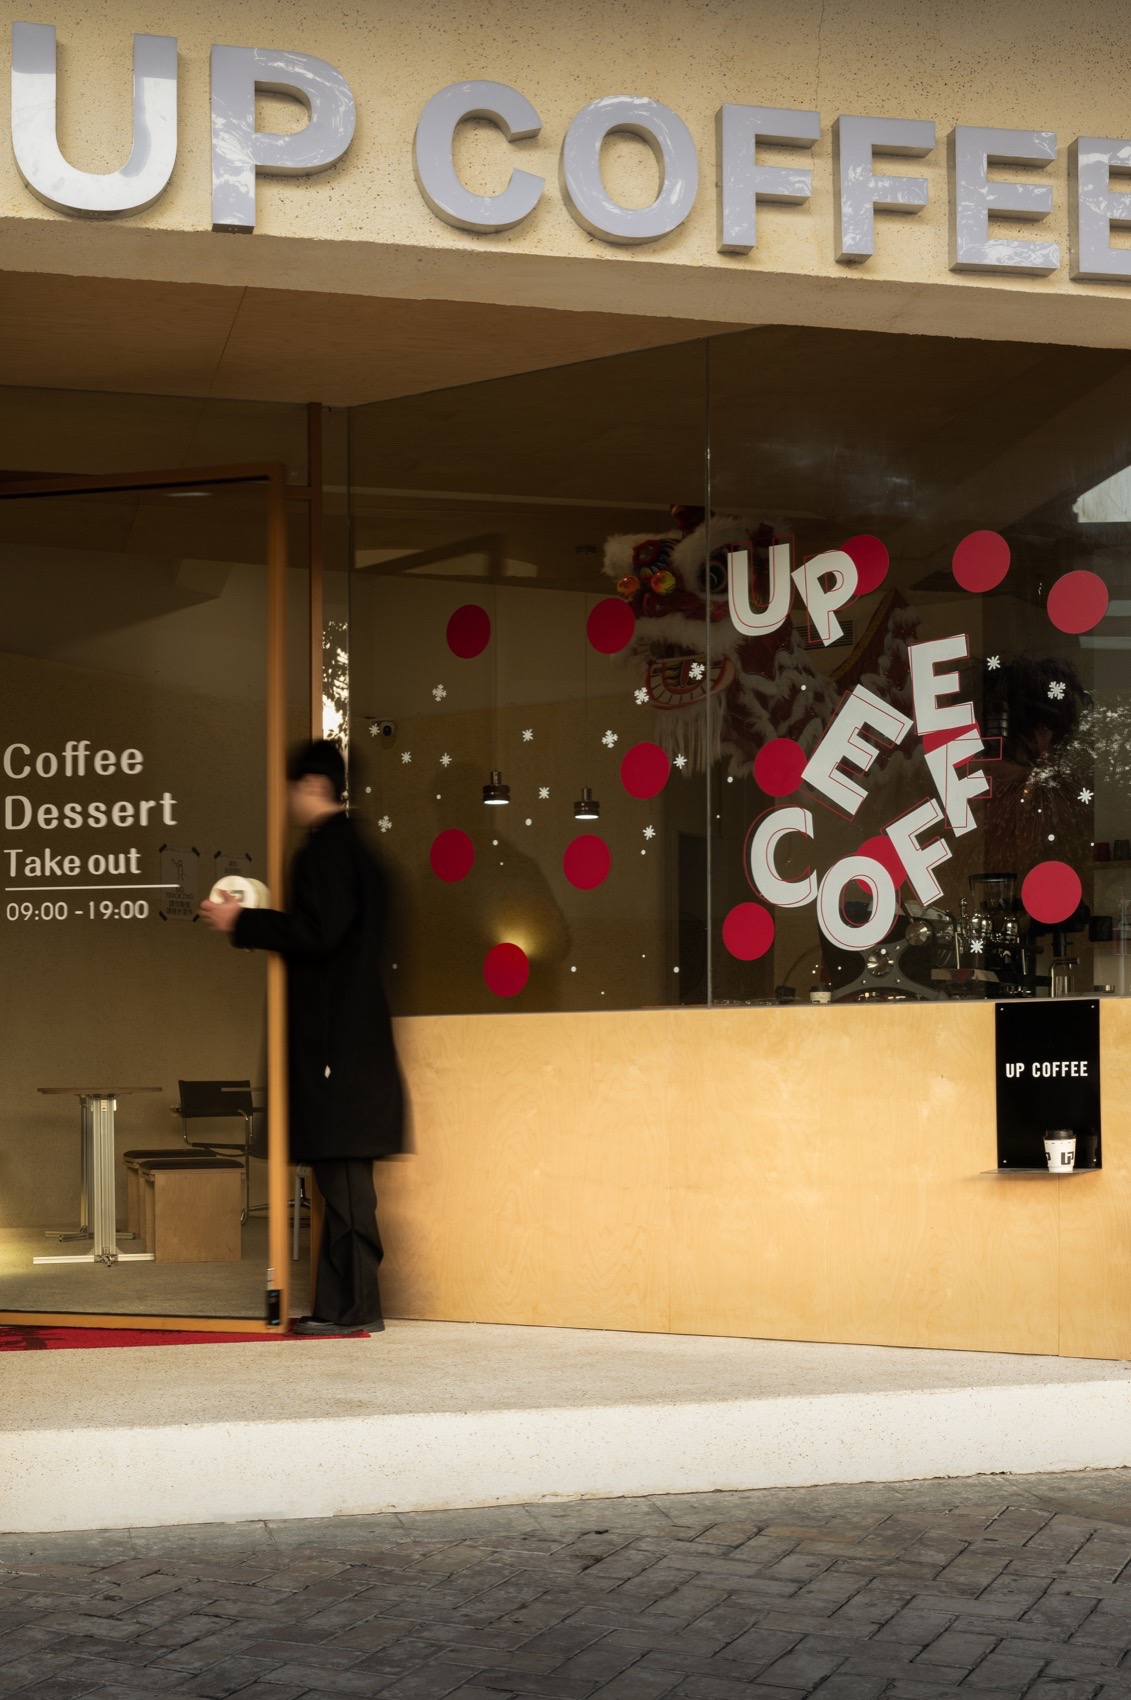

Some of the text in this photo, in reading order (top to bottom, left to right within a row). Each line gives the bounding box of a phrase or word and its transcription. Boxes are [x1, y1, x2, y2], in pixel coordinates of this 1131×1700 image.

[11, 21, 1131, 282] UP COFFEE
[728, 536, 861, 646] UP
[3, 740, 144, 779] Coffee
[5, 792, 178, 830] Dessert
[5, 848, 142, 877] Take out
[6, 902, 68, 920] 09:00
[1005, 1061, 1088, 1078] UP COFFEE
